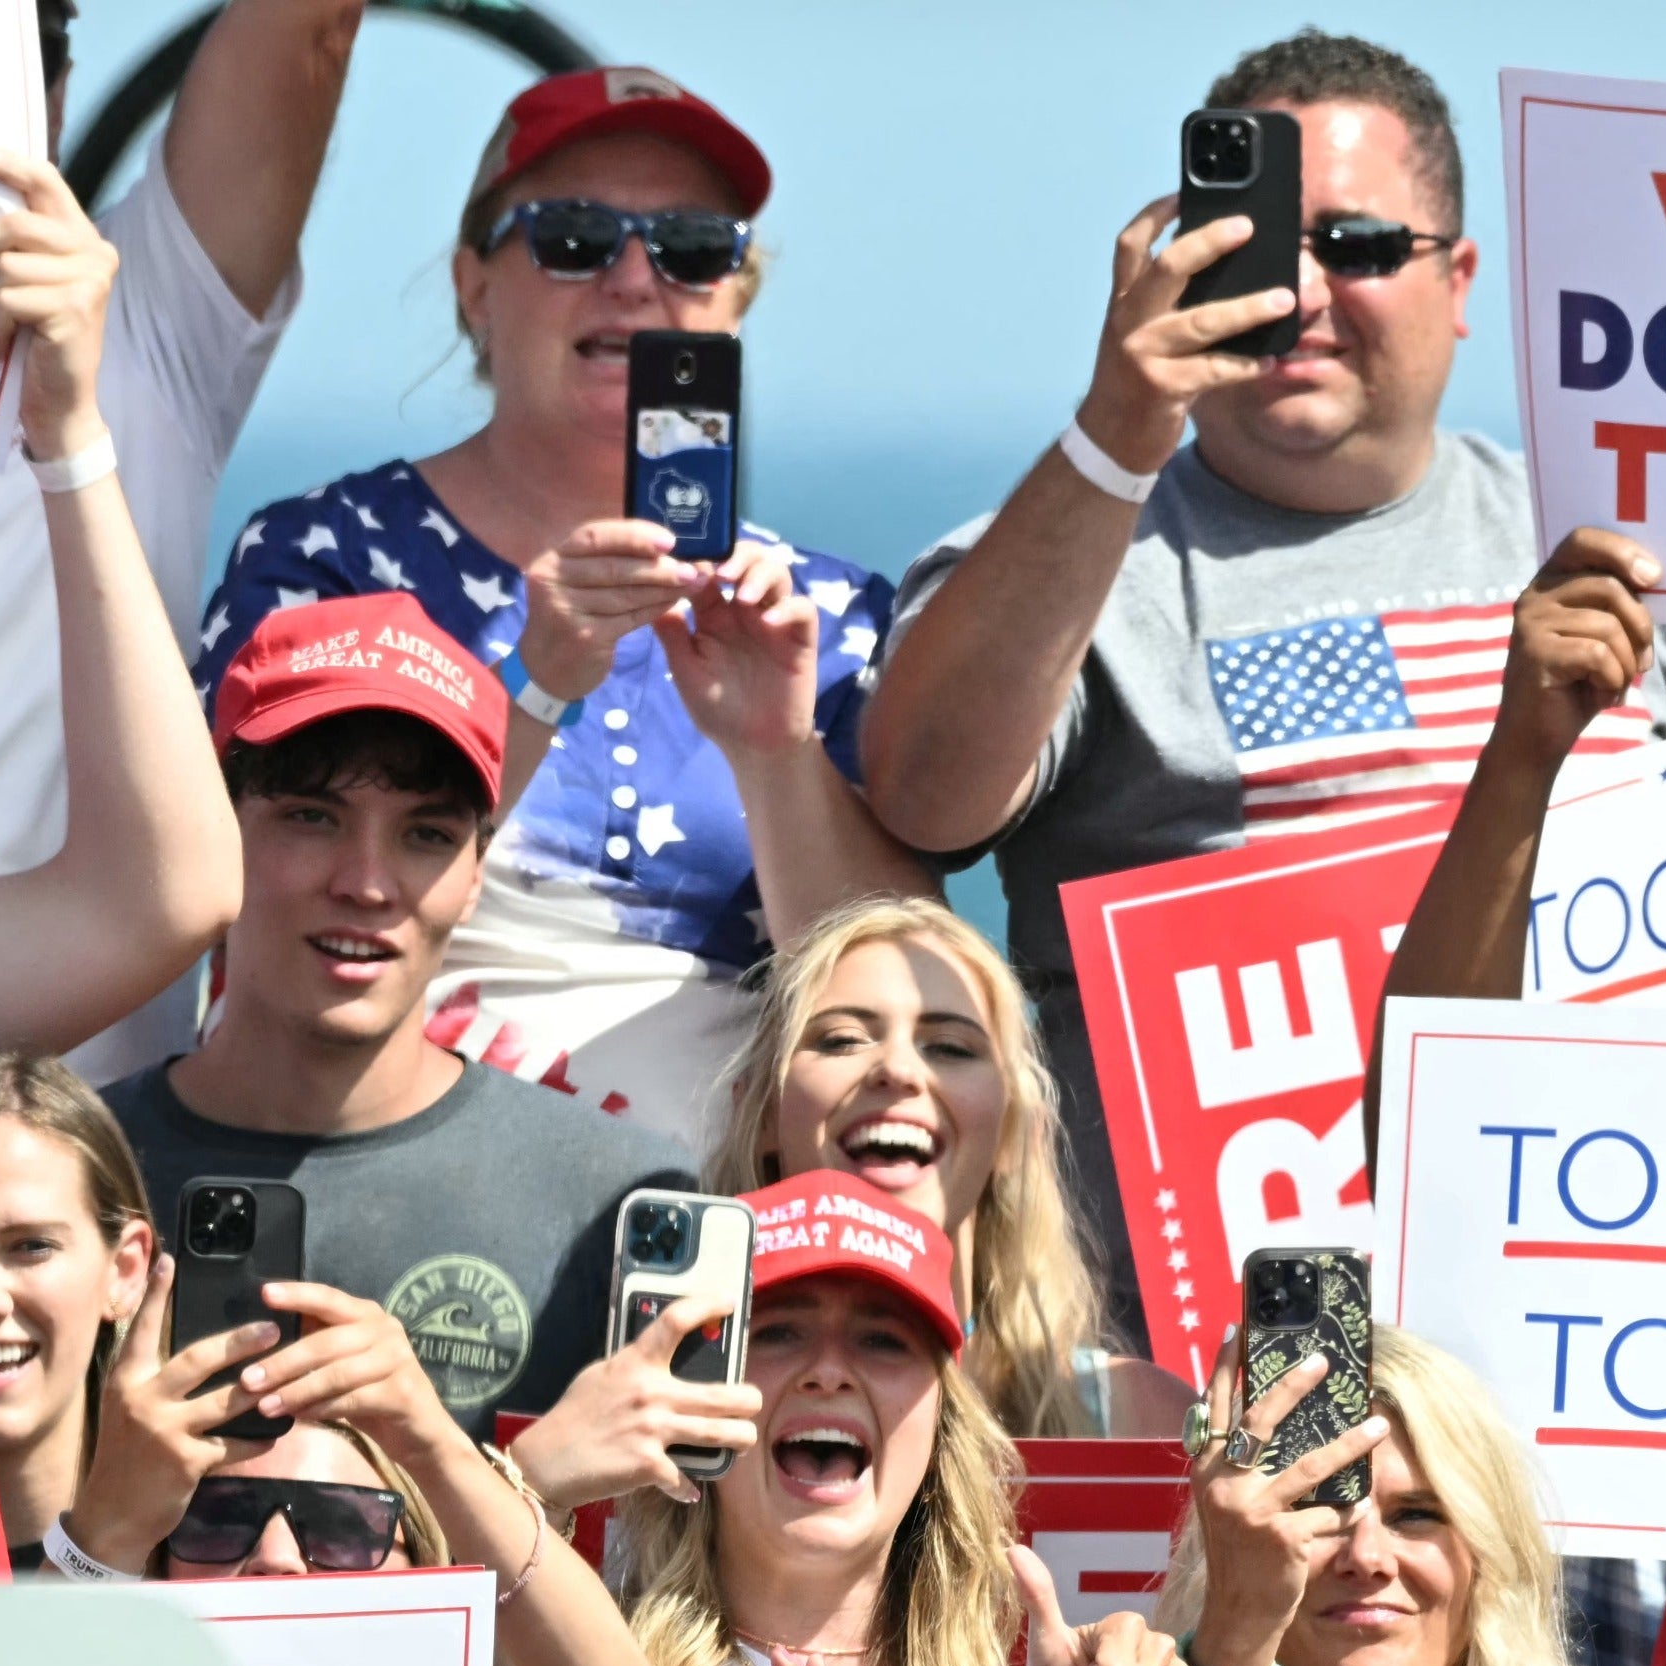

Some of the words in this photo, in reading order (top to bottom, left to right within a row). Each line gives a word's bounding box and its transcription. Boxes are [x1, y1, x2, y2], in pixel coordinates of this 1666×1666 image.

[287, 629, 361, 666] MAKE
[375, 625, 476, 701] AMERICA
[290, 649, 383, 674] GREAT
[396, 658, 470, 711] AGAIN
[1173, 936, 1375, 1286] RE
[752, 1220, 830, 1257] REAT
[839, 1225, 914, 1273] AGAIN
[756, 1198, 807, 1227] AKE
[815, 1193, 927, 1256] AMERICA
[396, 1270, 446, 1320] SAN
